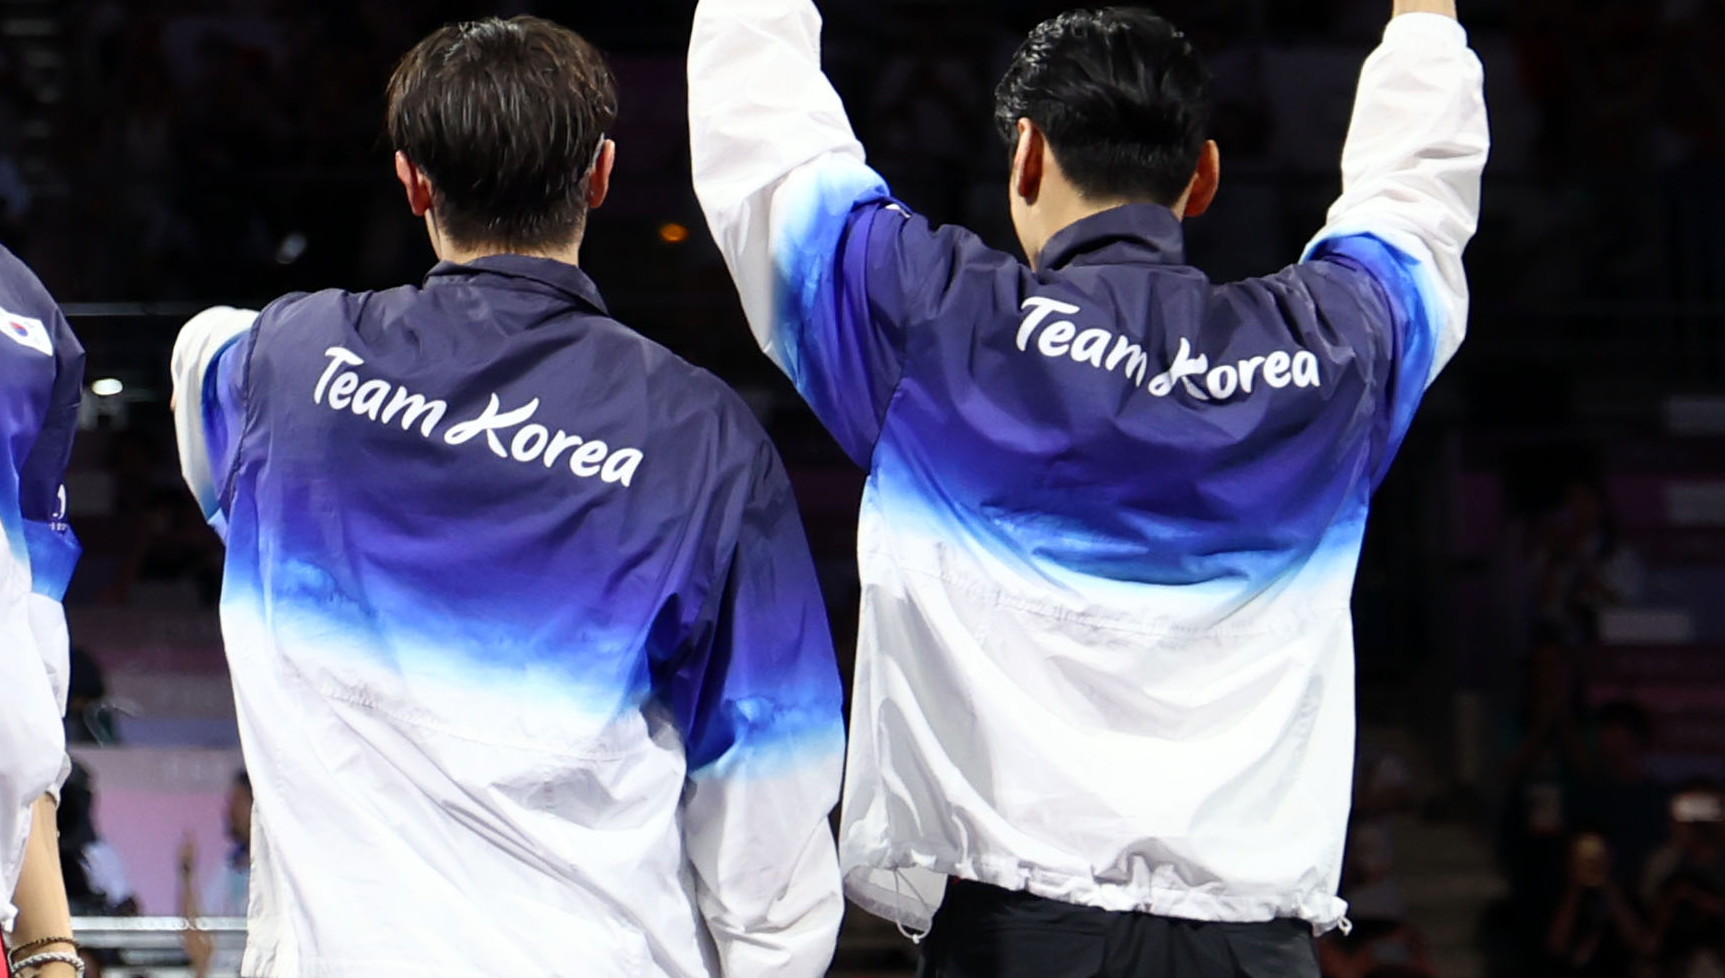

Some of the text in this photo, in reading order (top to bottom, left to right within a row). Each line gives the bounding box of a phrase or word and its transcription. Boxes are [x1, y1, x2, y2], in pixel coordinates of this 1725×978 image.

[1016, 296, 1320, 400] Team Korea
[314, 347, 643, 487] Team Korea
